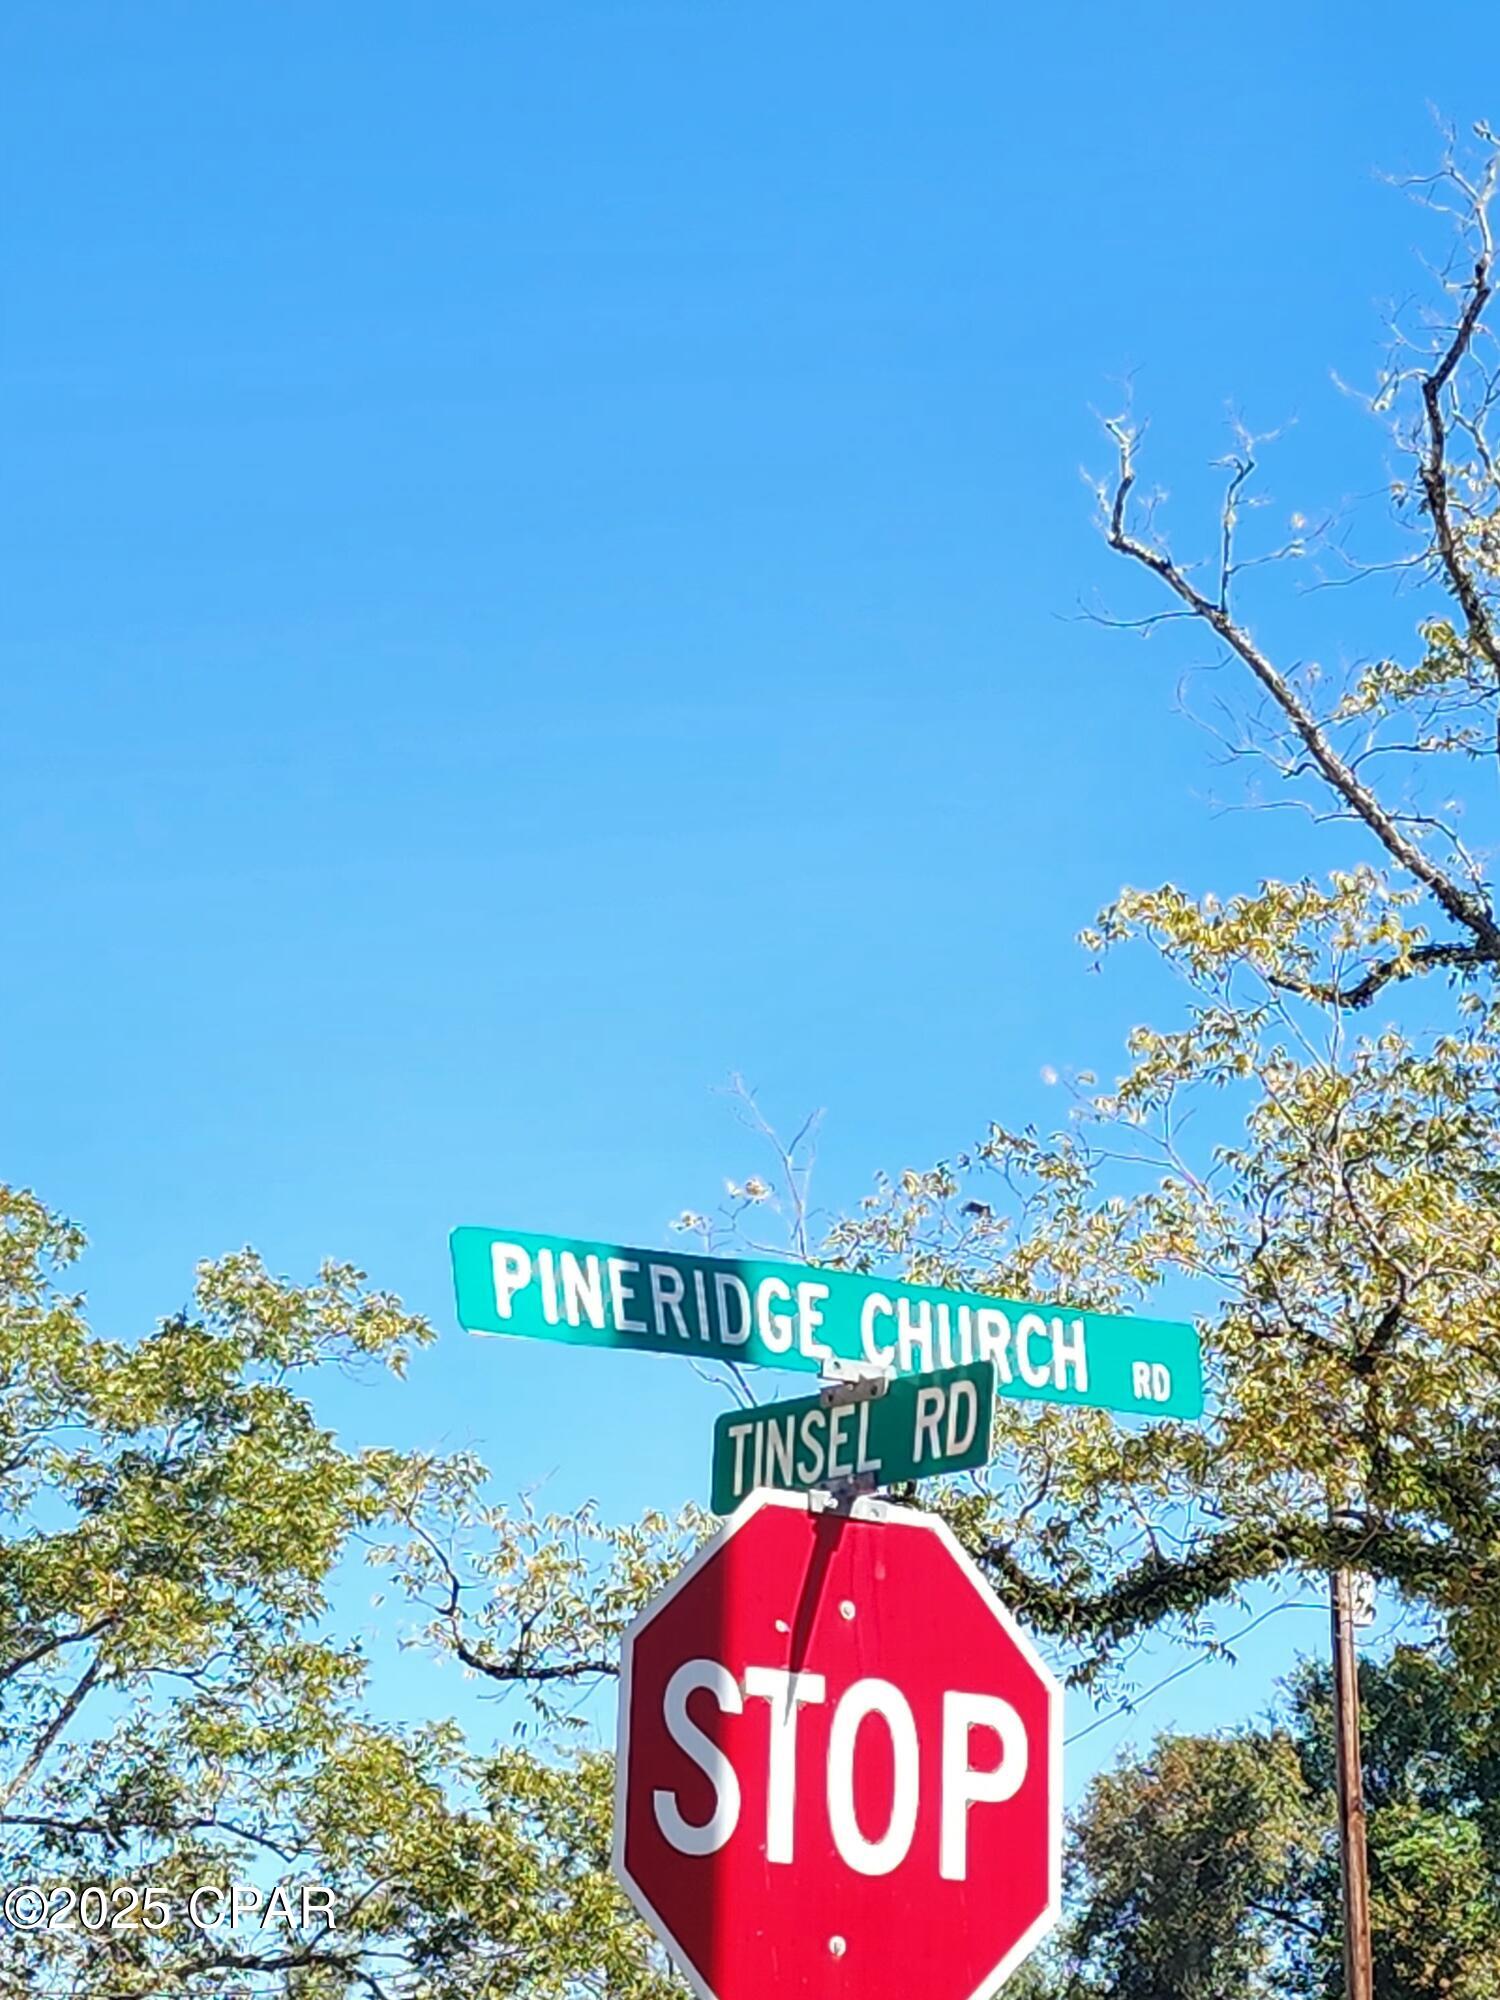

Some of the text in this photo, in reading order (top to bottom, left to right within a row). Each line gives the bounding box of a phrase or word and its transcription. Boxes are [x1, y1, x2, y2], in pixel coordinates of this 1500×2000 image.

[491, 1241, 1171, 1401] PINERIDGE CHURCH RD
[728, 1379, 978, 1497] TINSEL RD
[653, 1658, 1029, 1882] STOP
